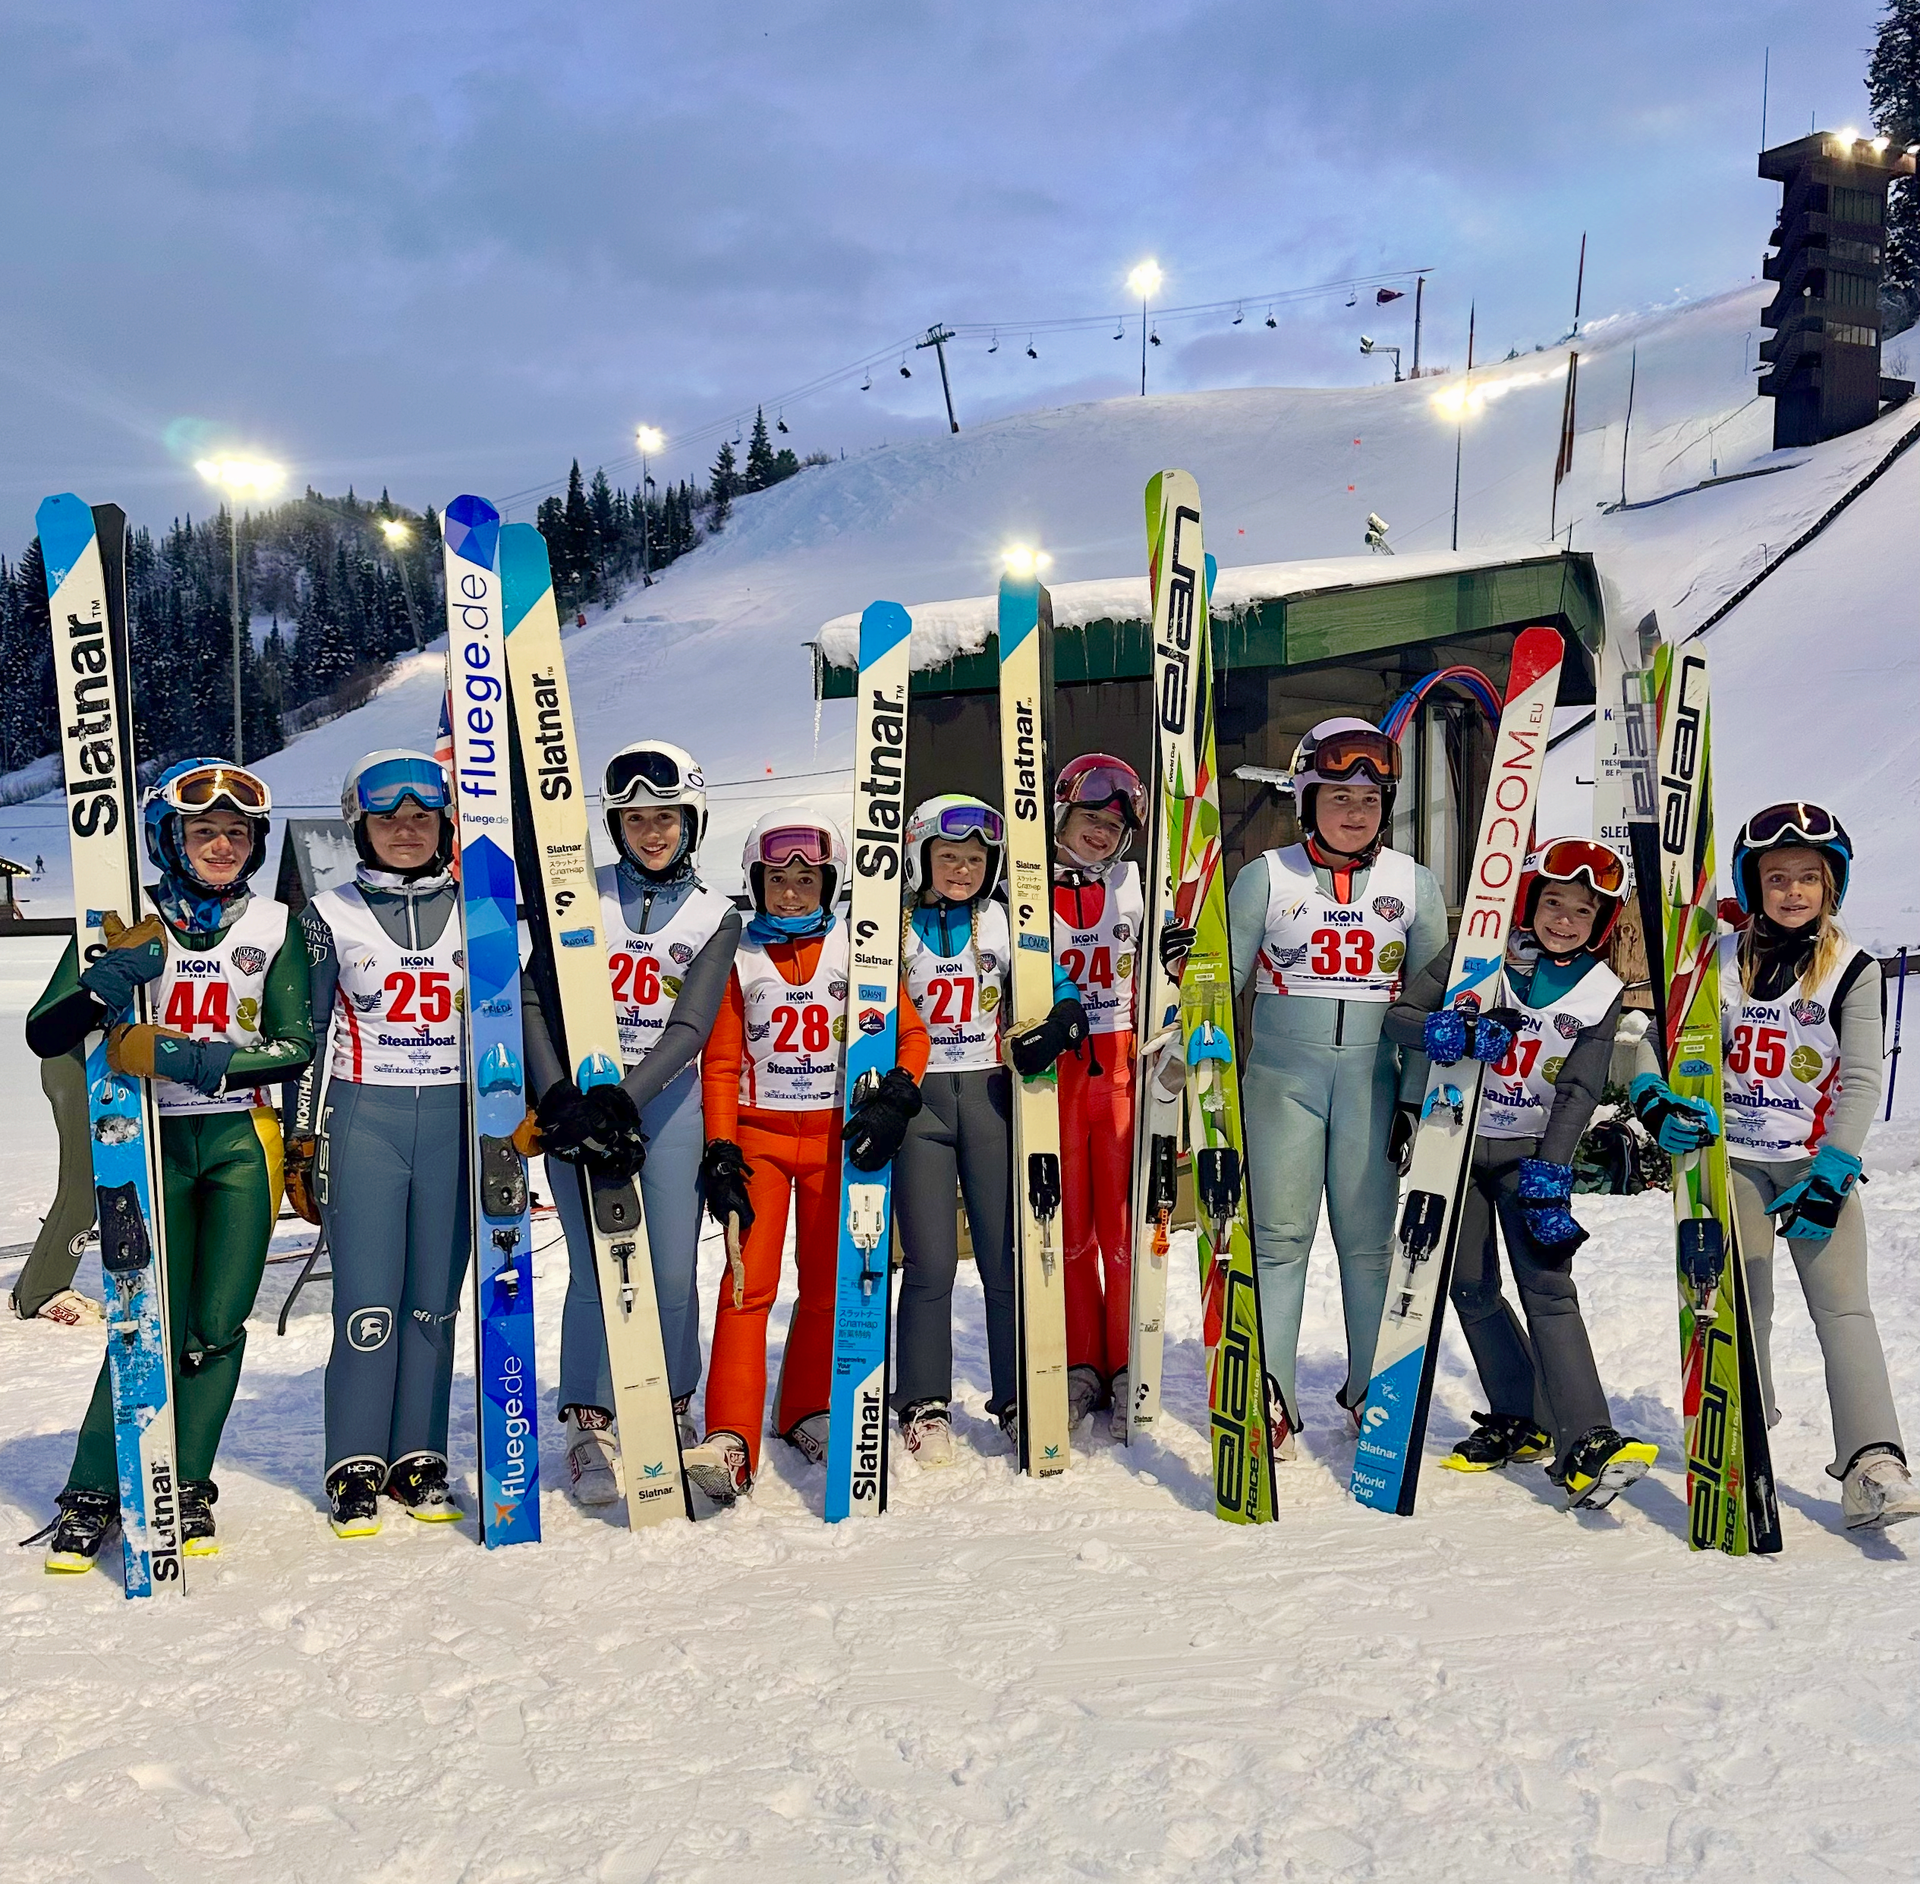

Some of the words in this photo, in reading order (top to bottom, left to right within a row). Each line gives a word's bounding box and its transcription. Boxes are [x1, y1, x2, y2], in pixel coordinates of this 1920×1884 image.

[1157, 505, 1200, 735] elan
[453, 574, 501, 798] fluege.de
[68, 613, 119, 838] Slatnar
[532, 673, 573, 801] Slatnar
[1015, 700, 1038, 822] Slatnar
[1661, 655, 1705, 855] elan
[855, 690, 904, 880] Slatnar
[462, 812, 509, 825] fluege.de
[547, 844, 582, 854] Slatnar
[1016, 860, 1041, 870] Slatnar
[301, 917, 332, 934] MAYO
[1324, 911, 1363, 923] IKON
[625, 939, 653, 950] IKON
[1071, 934, 1099, 944] IKON
[400, 956, 434, 967] IKON
[854, 953, 893, 966] Slatnar
[1311, 929, 1375, 976] 33
[177, 959, 221, 974] IKON
[936, 963, 963, 974] IKON
[1059, 946, 1114, 991] 24
[609, 953, 660, 1005] 26
[384, 972, 452, 1023] 25
[785, 991, 814, 1001] IKON
[927, 977, 975, 1025] 27
[164, 981, 230, 1034] 44
[1742, 1006, 1780, 1021] IKON
[378, 1027, 457, 1047] Steamboat
[771, 1004, 830, 1053] 28
[1728, 1025, 1787, 1079] 35
[373, 1064, 414, 1074] Steamboat
[414, 1066, 440, 1076] Springs
[767, 1058, 836, 1075] Steamboat
[1746, 1135, 1778, 1148] Springs
[838, 1309, 882, 1318] スラットナー
[838, 1318, 878, 1330] Слатнар
[1211, 1269, 1254, 1513] elan
[498, 1355, 530, 1497] fluege.de
[852, 1391, 880, 1501] Slatnar
[1688, 1328, 1733, 1551] elan
[1730, 1428, 1738, 1456] World
[1359, 1440, 1398, 1460] Slatnar
[1353, 1470, 1387, 1490] World
[638, 1486, 674, 1500] Slatnar
[1351, 1483, 1374, 1500] Cup
